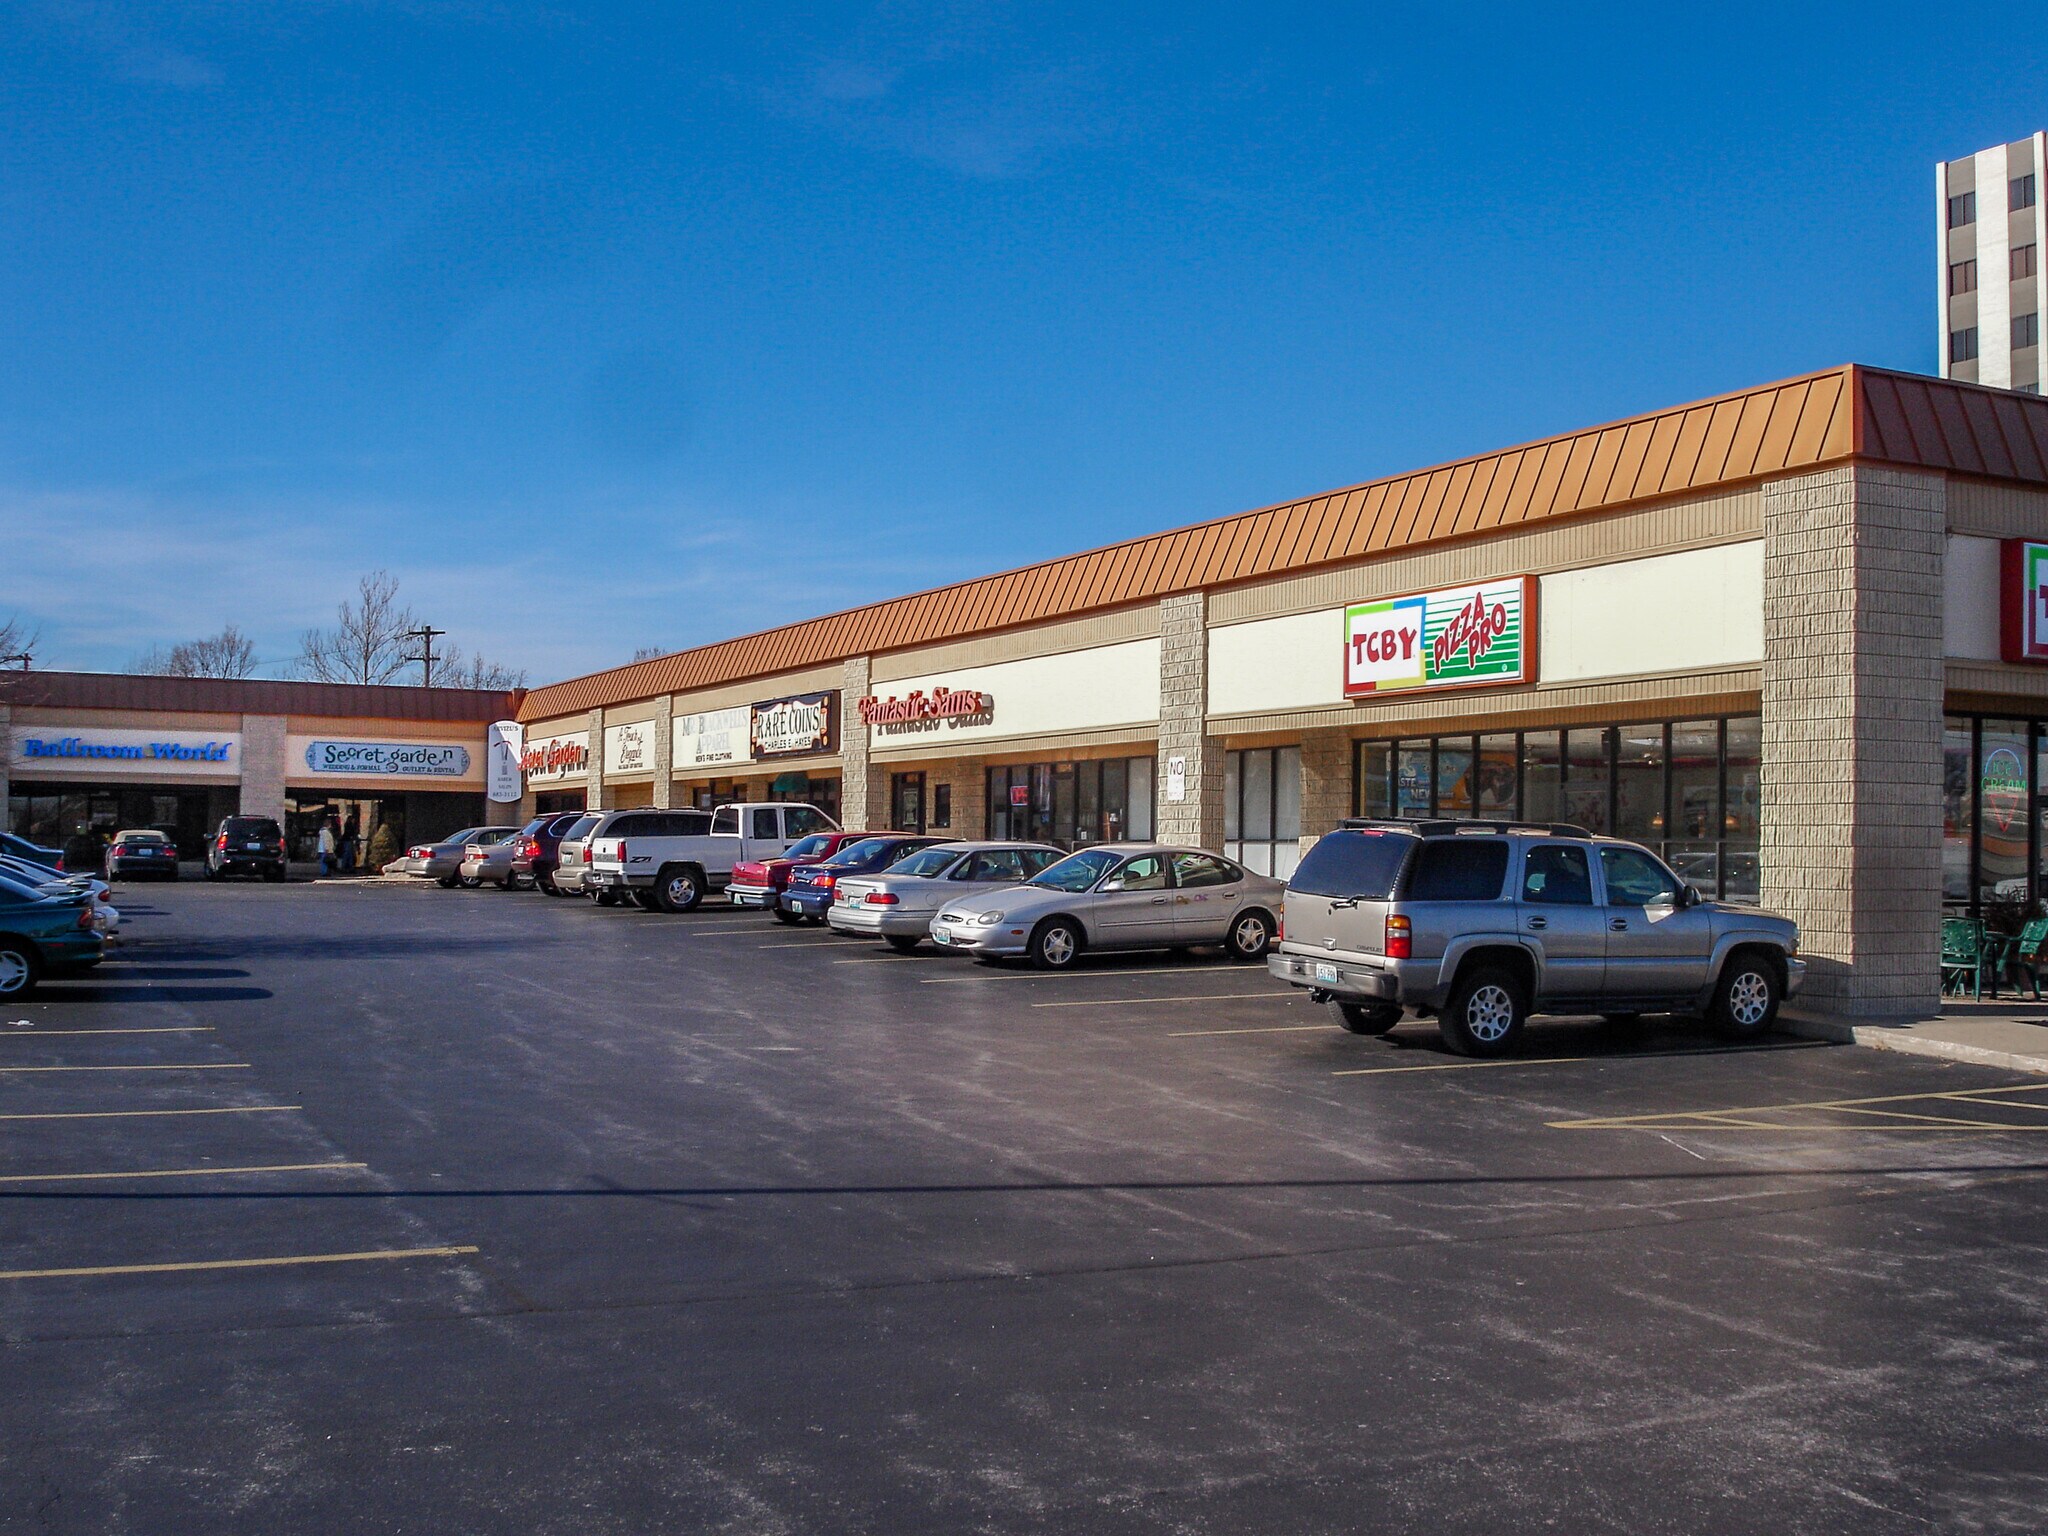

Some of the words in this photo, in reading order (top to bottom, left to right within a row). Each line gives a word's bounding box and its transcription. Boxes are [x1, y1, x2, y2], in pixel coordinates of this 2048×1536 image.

[1353, 627, 1417, 665] TCBY
[1434, 591, 1485, 673] PIZZA
[1469, 603, 1507, 669] PRO
[858, 691, 926, 725] Fantastic
[929, 687, 981, 719] Sams
[757, 711, 787, 739] RARE
[788, 706, 820, 734] COINS
[24, 738, 146, 759] Ballroom
[150, 742, 233, 761] World
[516, 743, 546, 771] Secret
[547, 739, 584, 767] Garden
[764, 739, 788, 751] CHARLES
[794, 736, 811, 747] HAYES
[325, 745, 385, 764] Secret
[386, 748, 453, 773] garden
[1169, 760, 1184, 775] NO
[1993, 760, 2012, 776] ICE
[1981, 776, 2027, 792] CREAM
[629, 856, 653, 864] Z71
